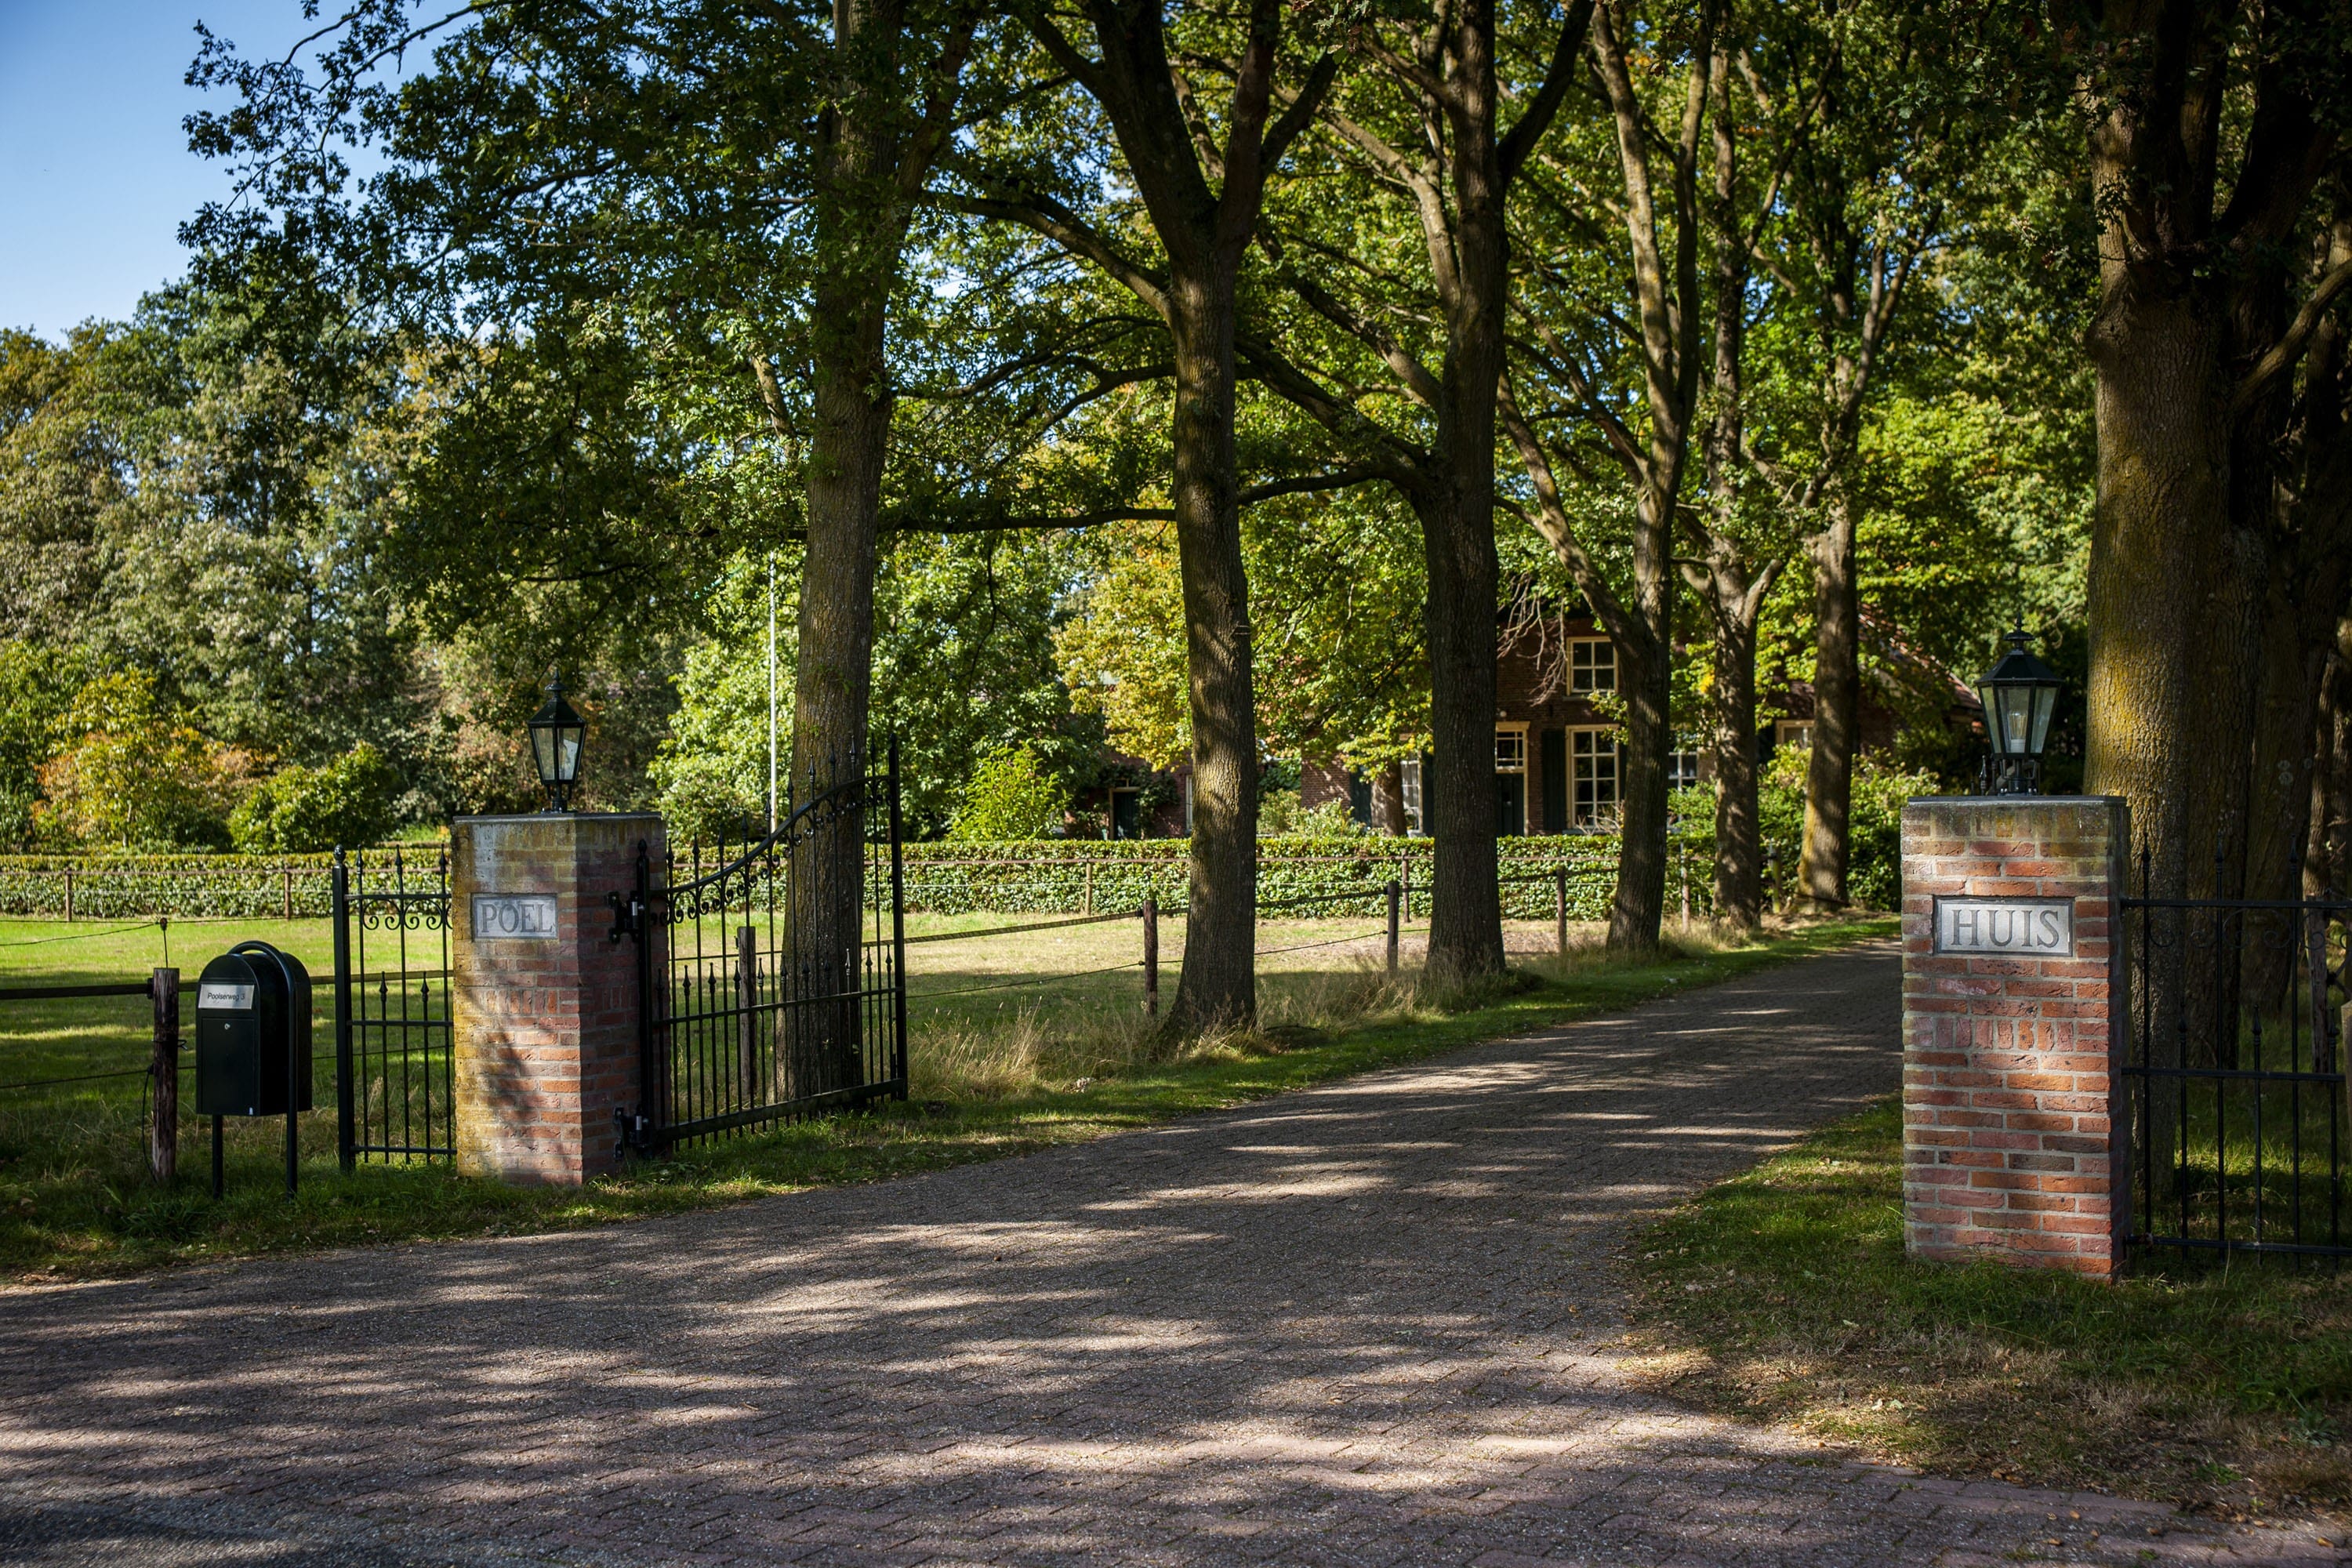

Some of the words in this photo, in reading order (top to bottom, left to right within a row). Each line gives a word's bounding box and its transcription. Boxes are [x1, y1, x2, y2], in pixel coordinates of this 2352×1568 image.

[481, 903, 554, 933] POEL
[1951, 909, 2060, 949] HUIS
[207, 992, 240, 1001] Poolserweg
